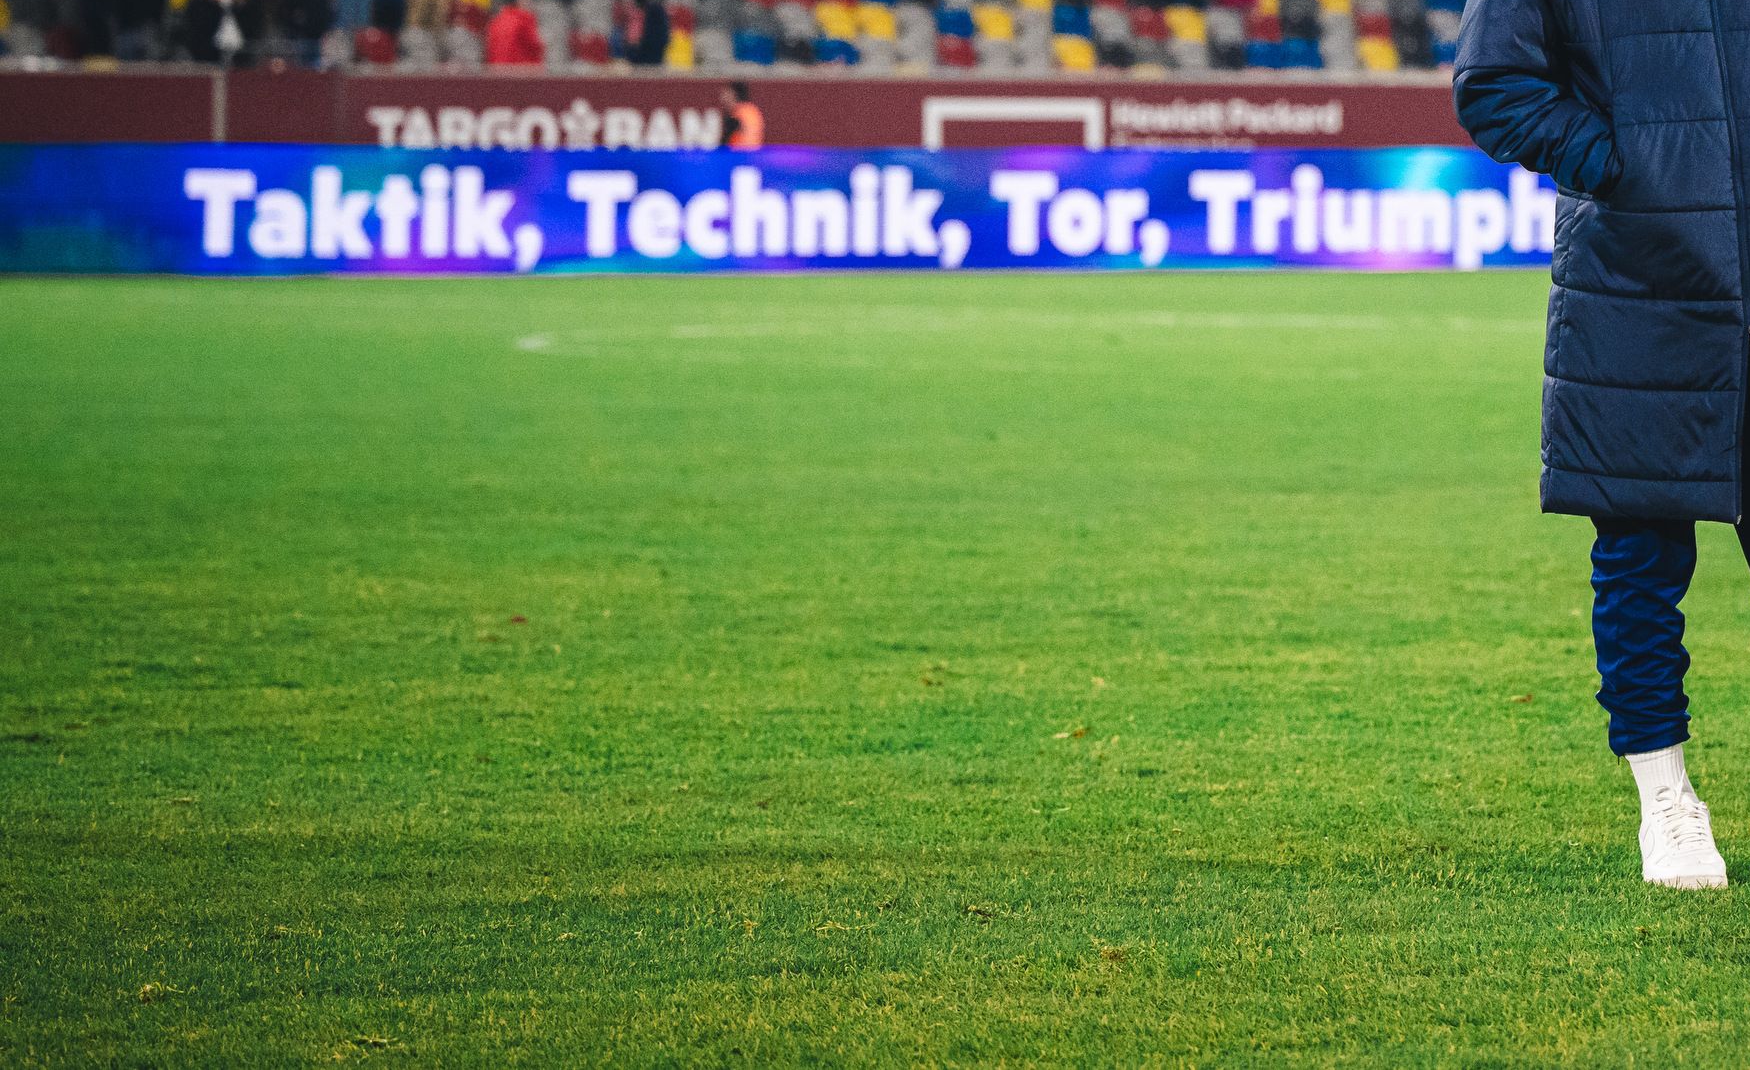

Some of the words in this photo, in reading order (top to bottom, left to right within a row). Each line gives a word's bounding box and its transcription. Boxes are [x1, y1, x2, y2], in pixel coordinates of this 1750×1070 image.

[184, 164, 543, 271] Taktik,
[567, 164, 971, 269] Technik,
[990, 169, 1171, 268] Tor,
